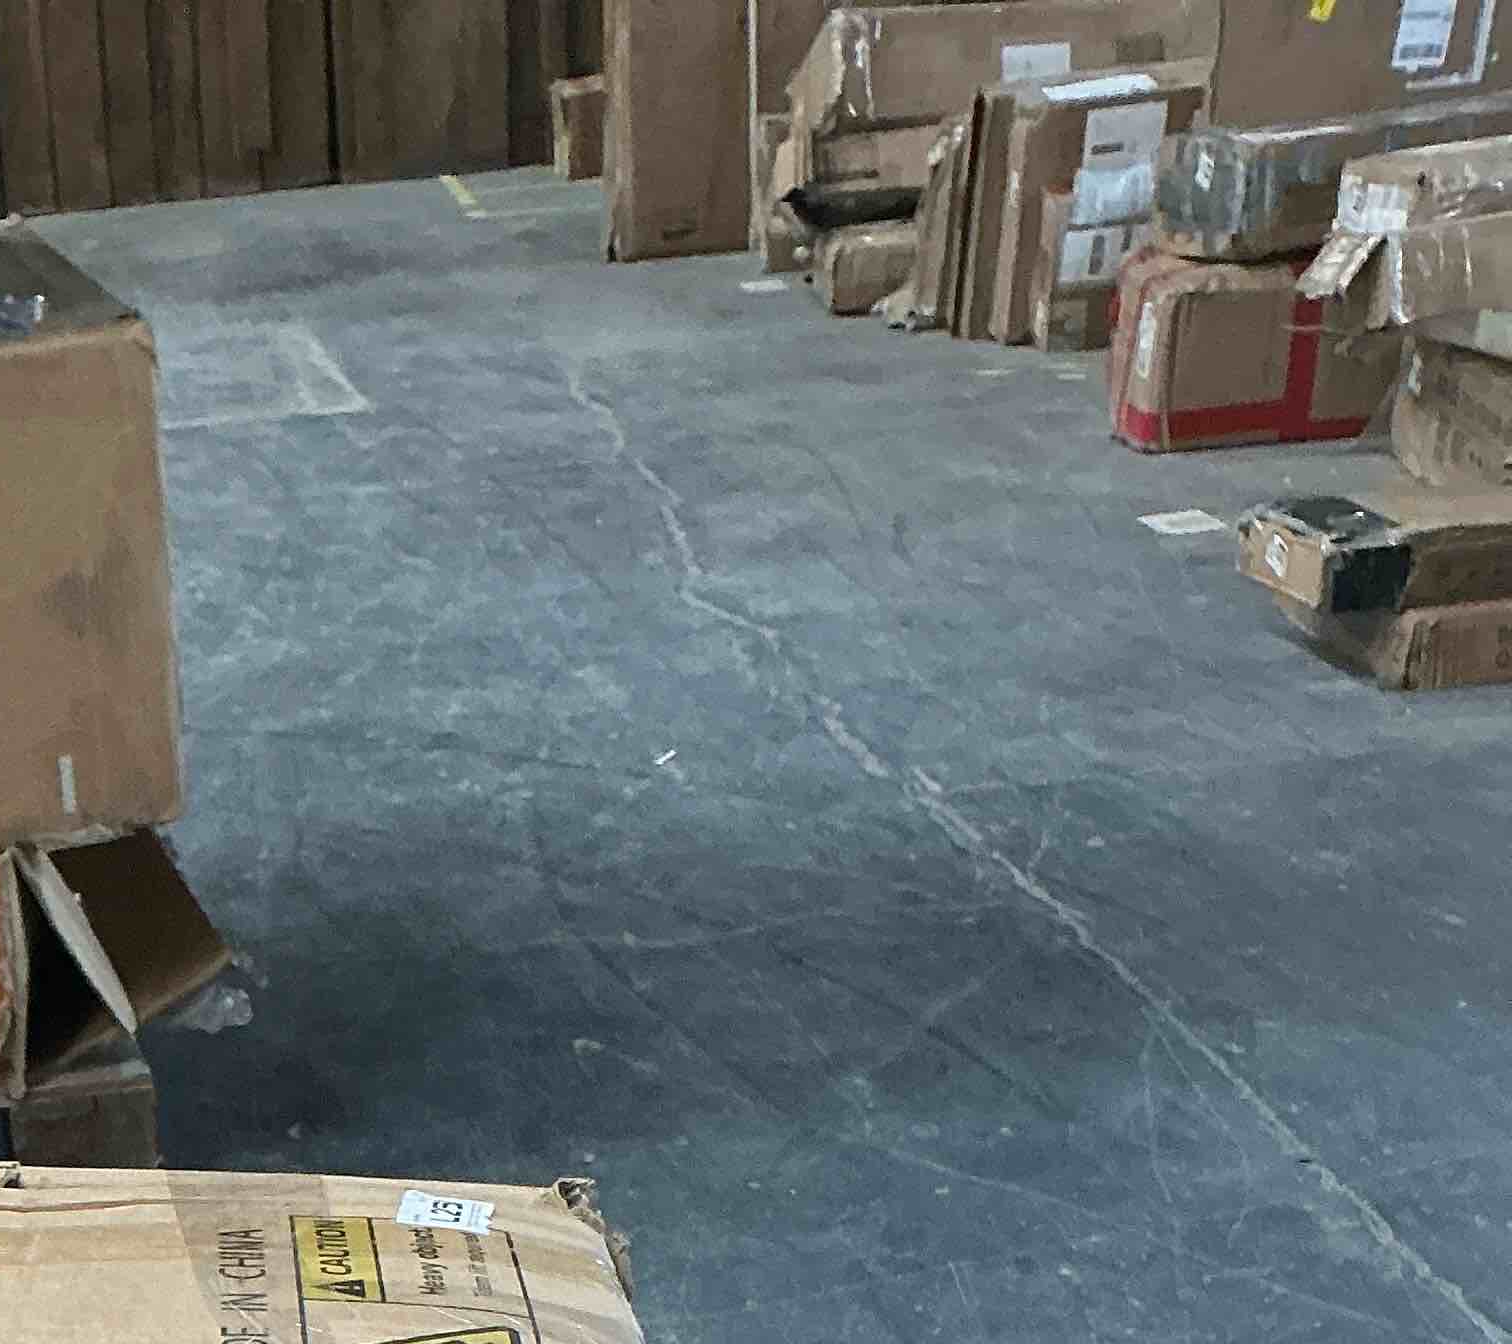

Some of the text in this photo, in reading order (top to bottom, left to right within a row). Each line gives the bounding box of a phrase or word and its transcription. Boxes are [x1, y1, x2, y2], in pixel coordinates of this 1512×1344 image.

[217, 1228, 266, 1280] CHINA
[313, 1219, 352, 1277] CAUTION
[220, 1293, 269, 1313] IN
